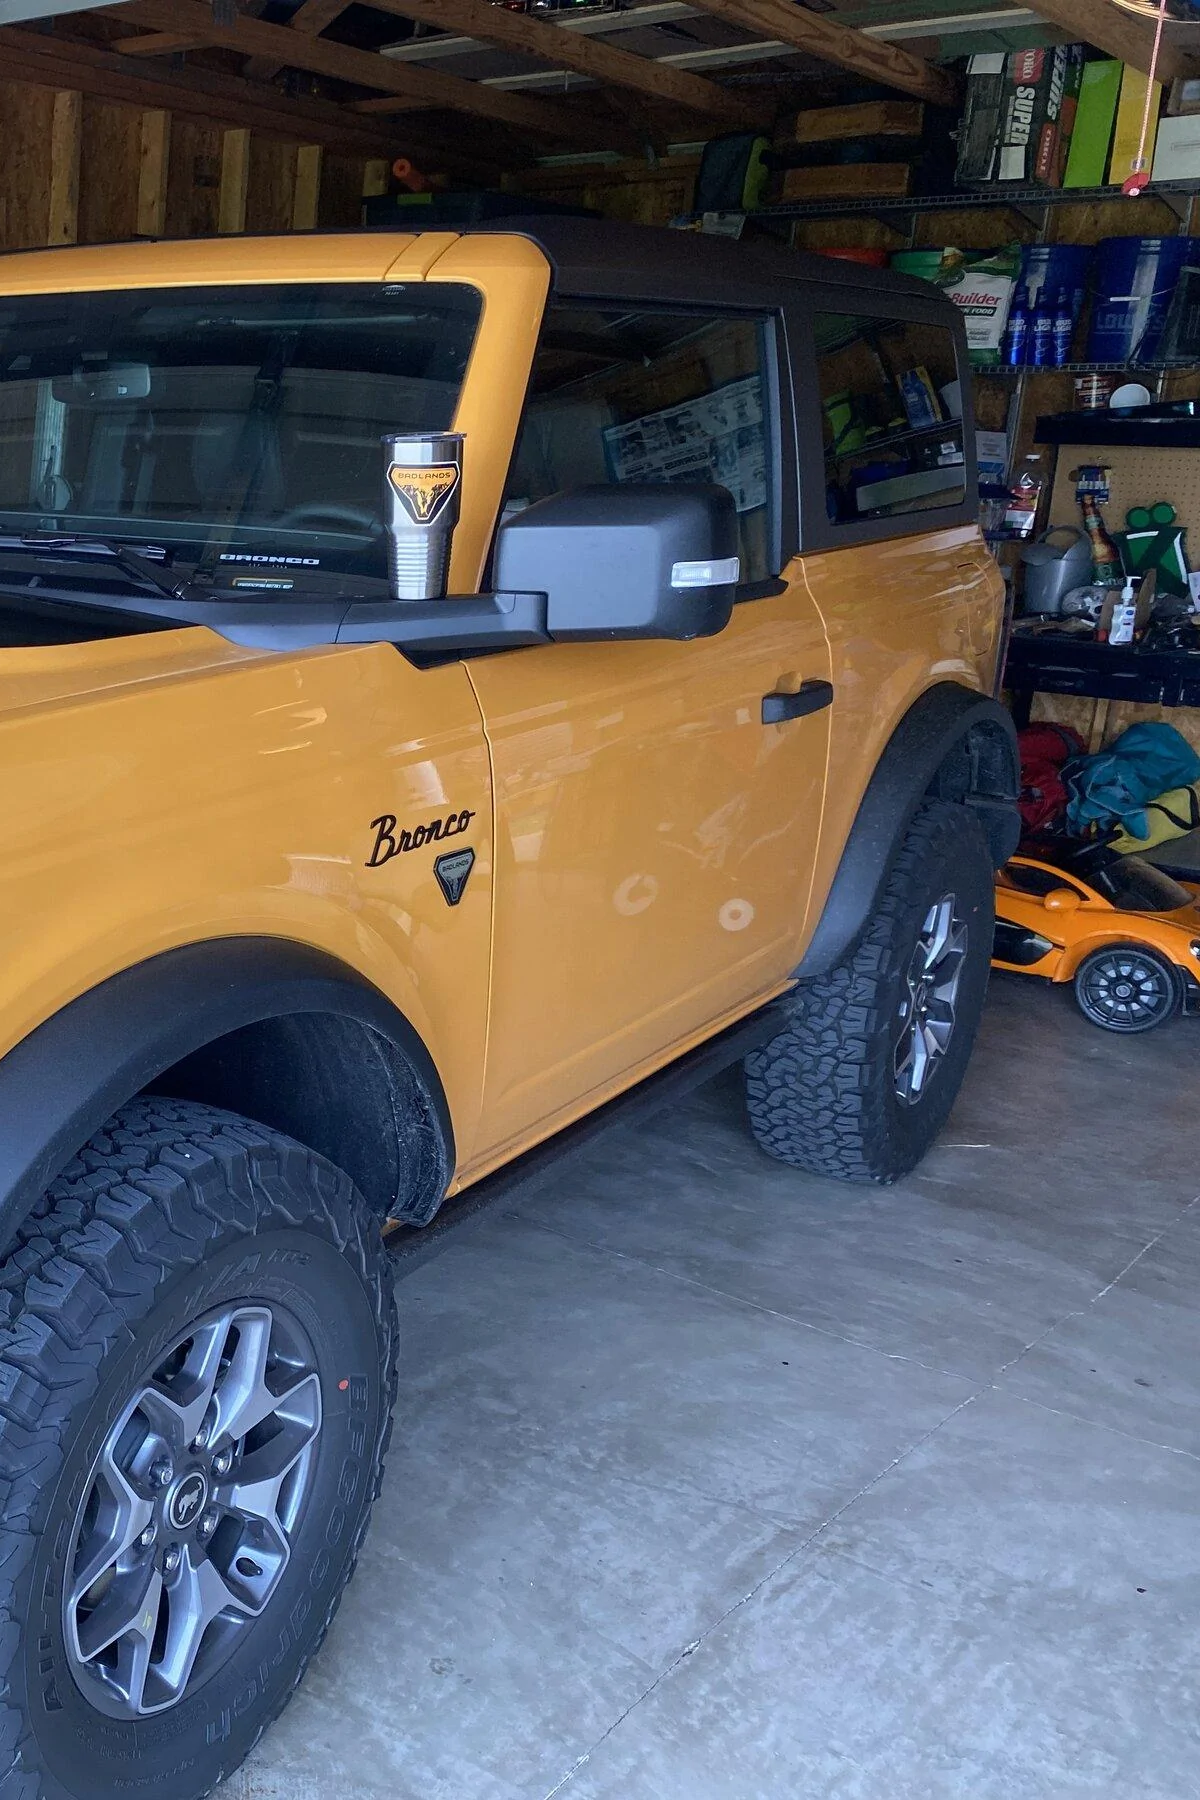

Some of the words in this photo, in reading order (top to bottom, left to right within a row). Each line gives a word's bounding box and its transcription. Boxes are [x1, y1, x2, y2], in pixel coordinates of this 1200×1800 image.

[1010, 86, 1036, 145] SUPER
[951, 292, 1002, 306] Builder
[398, 472, 451, 480] BADLANDS
[220, 553, 320, 565] BRONCO
[365, 809, 476, 867] Bronco
